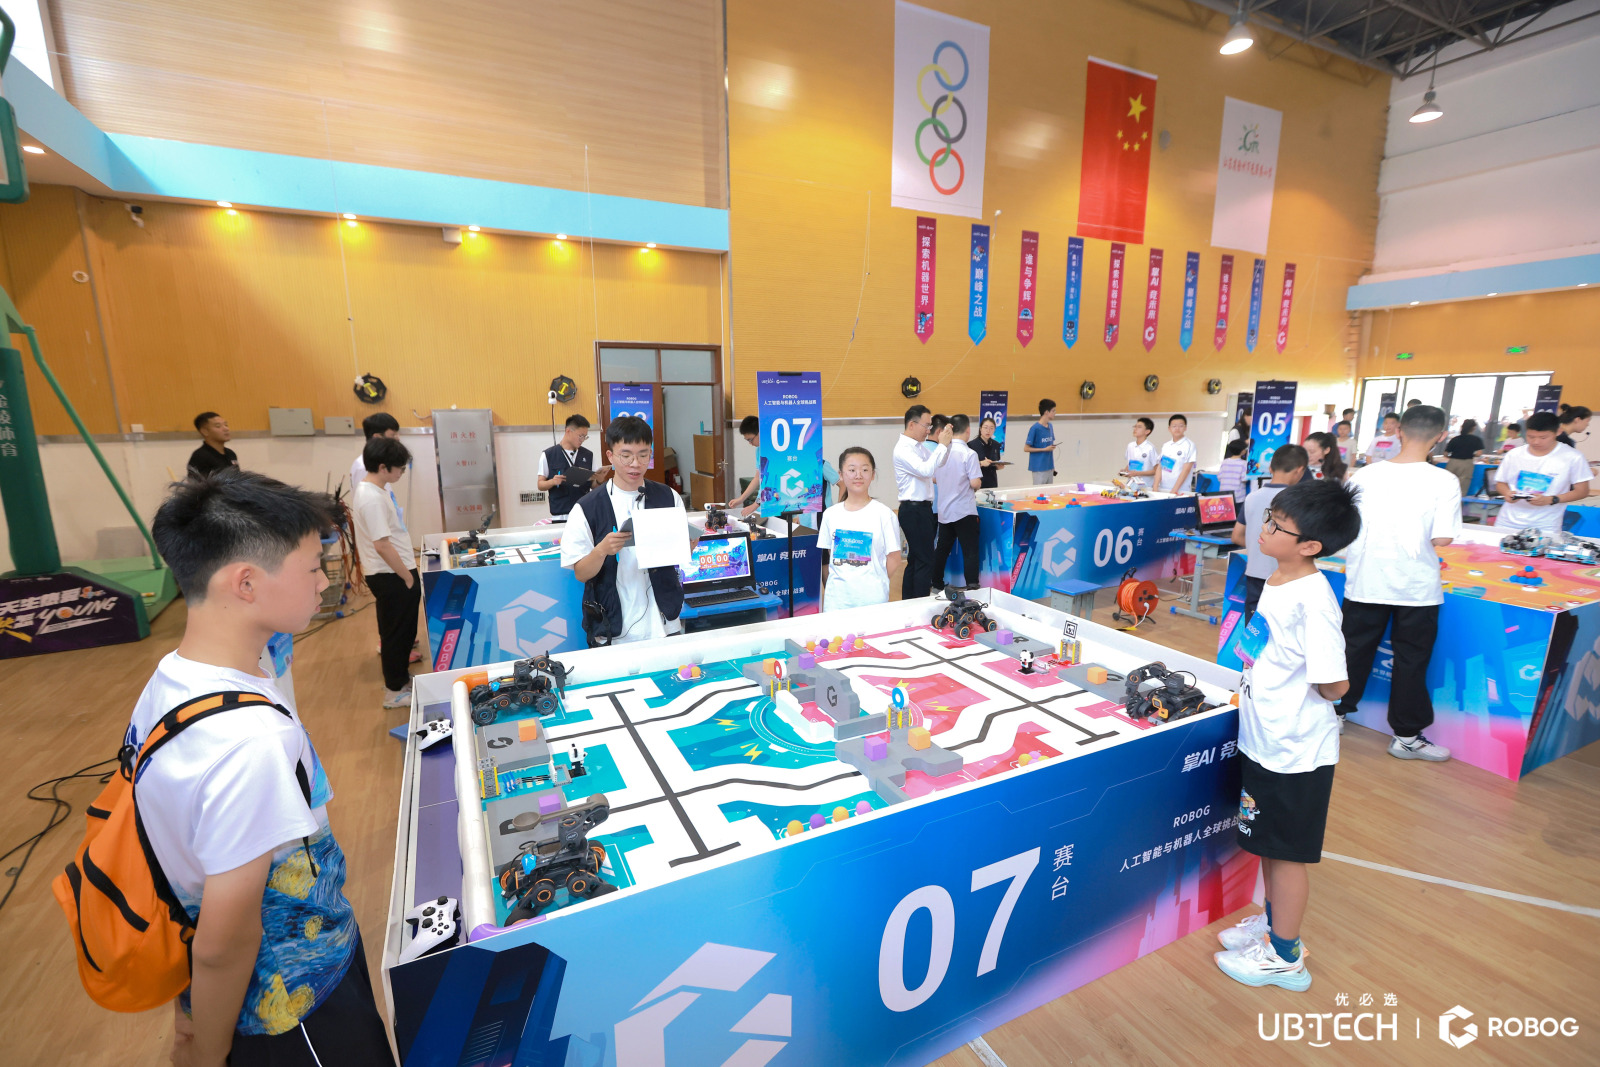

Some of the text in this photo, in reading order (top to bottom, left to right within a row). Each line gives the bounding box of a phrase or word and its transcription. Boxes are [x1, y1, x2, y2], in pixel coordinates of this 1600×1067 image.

[920, 236, 931, 306] 探索机器世界
[973, 267, 984, 318] 巅峰之战
[770, 417, 812, 452] 07
[1257, 411, 1288, 436] 05
[756, 552, 777, 563] 掌AI
[1094, 525, 1135, 568] 06
[1181, 746, 1217, 773] 掌AI
[1173, 804, 1211, 828] ROBOG
[1051, 843, 1075, 901] 赛台
[878, 846, 1041, 1013] 07
